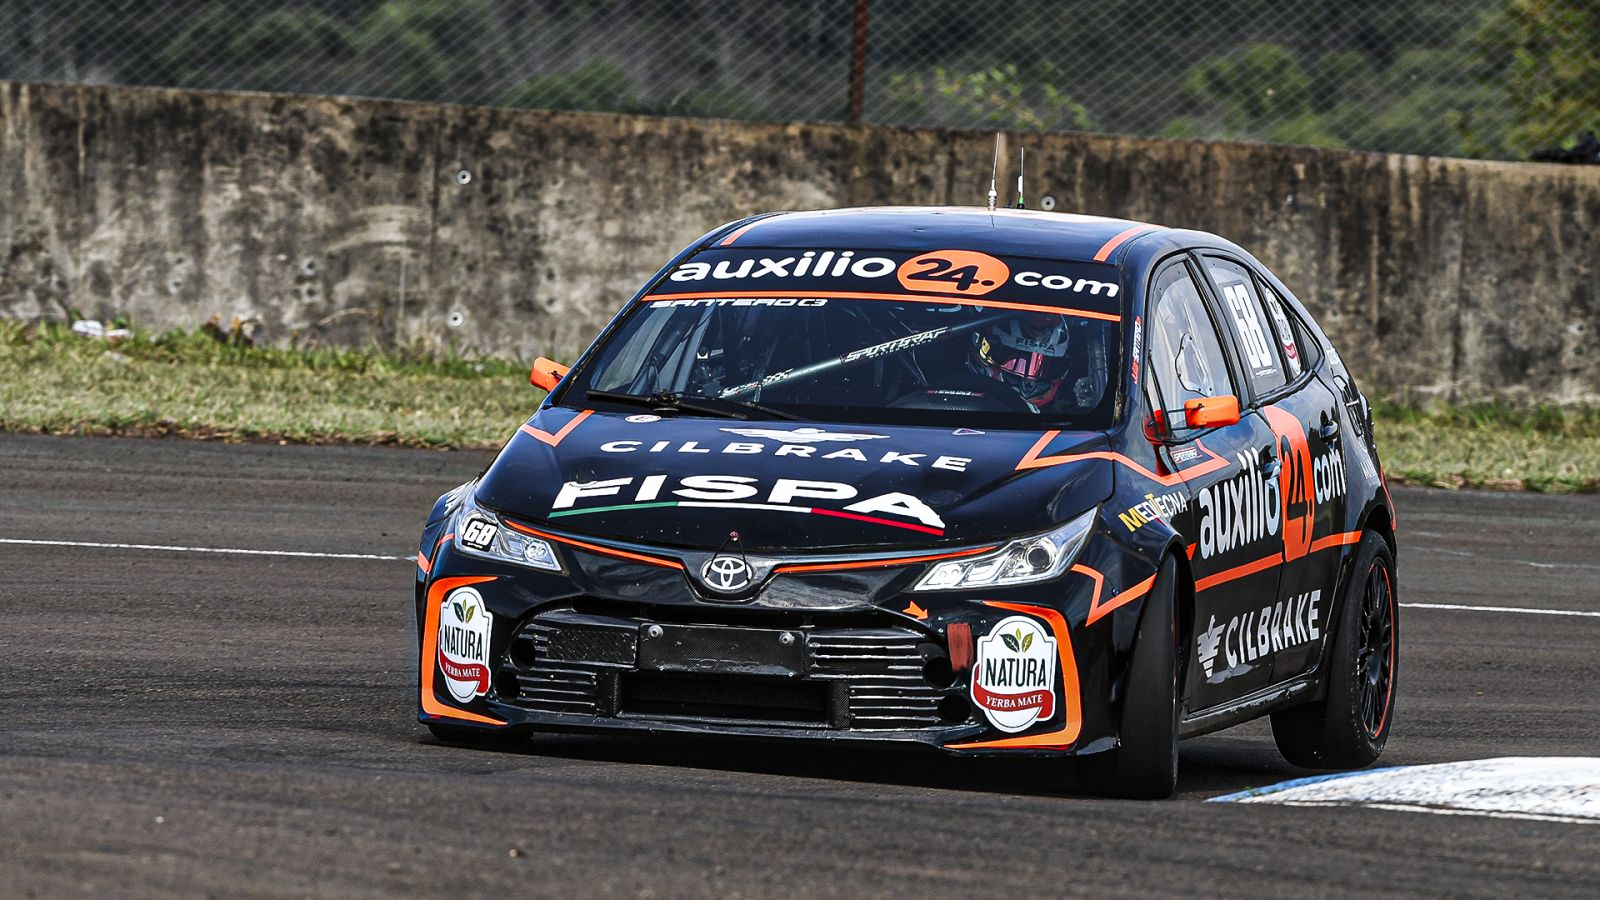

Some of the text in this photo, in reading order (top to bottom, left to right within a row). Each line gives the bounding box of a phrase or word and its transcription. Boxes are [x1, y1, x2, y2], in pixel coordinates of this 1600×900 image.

[670, 251, 896, 281] auxilio
[1014, 271, 1120, 298] com
[1222, 284, 1273, 369] 68
[600, 440, 972, 473] CILBRAKE
[552, 474, 946, 529] FISPA
[1199, 446, 1280, 560] auxilio
[1313, 448, 1347, 505] com
[463, 520, 498, 546] 68
[444, 623, 483, 662] NATURA
[1225, 589, 1322, 669] CILBRAKE
[462, 667, 481, 678] MATE
[984, 657, 1047, 688] NATURA
[985, 694, 1043, 708] YERBA MATE
